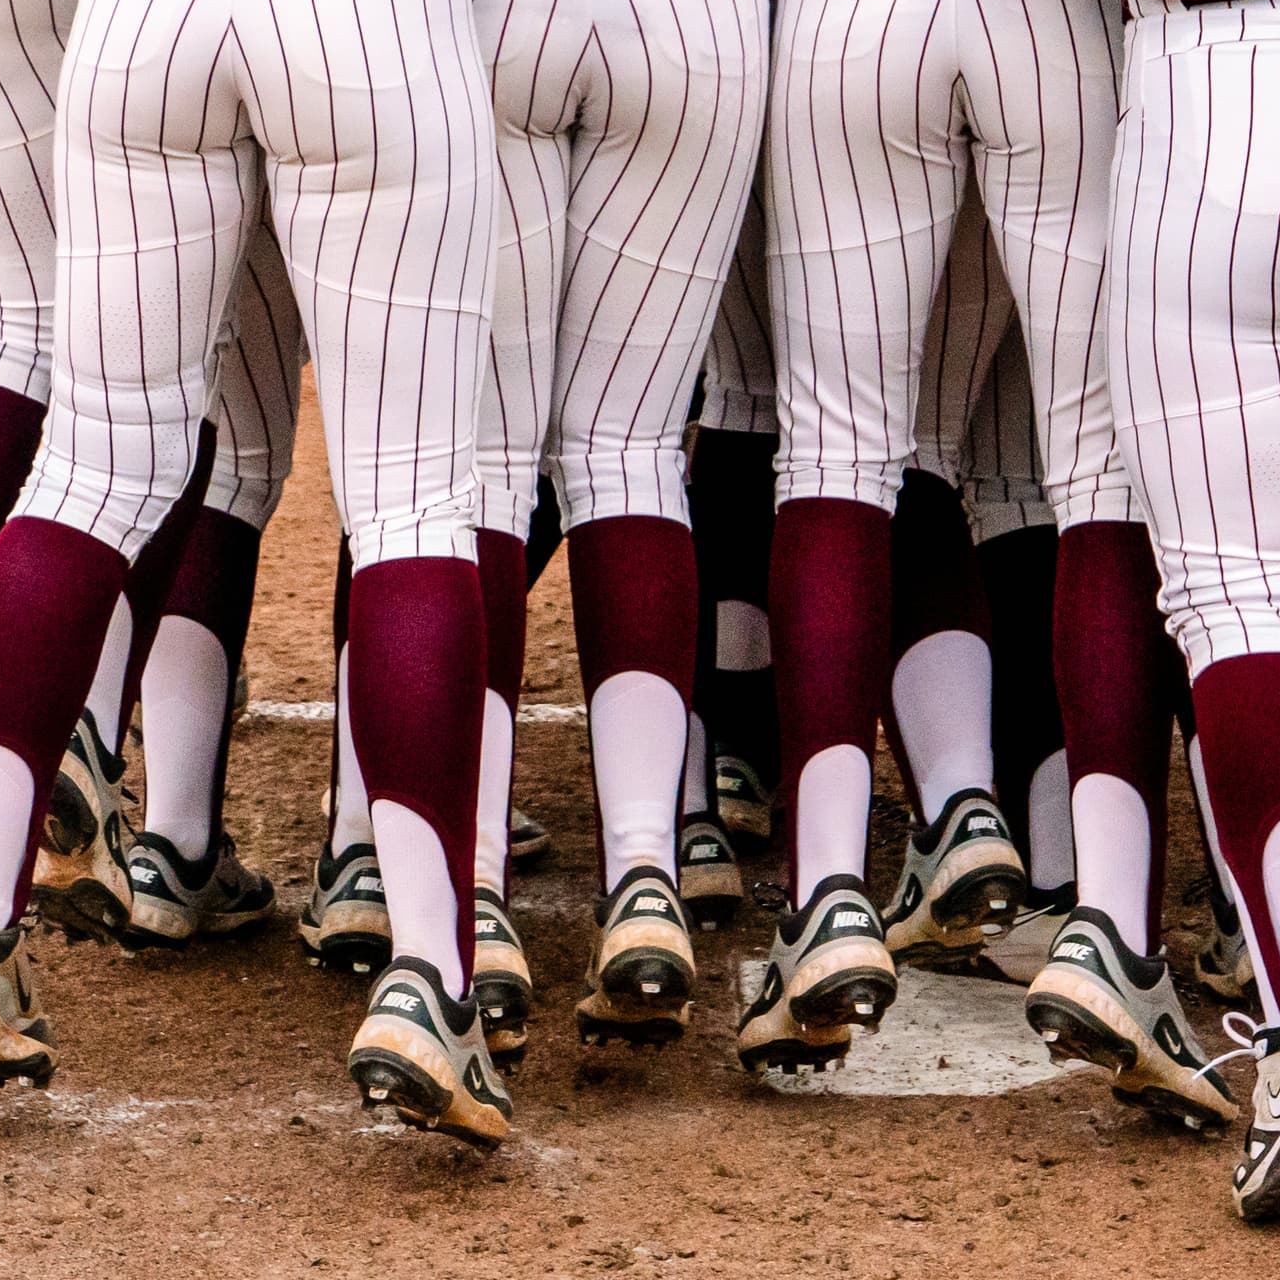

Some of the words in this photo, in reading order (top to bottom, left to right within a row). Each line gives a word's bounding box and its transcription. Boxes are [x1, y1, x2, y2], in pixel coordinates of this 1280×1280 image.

[967, 816, 999, 832] NIKE
[632, 896, 670, 913] NIKE
[832, 911, 870, 929] NIKE
[1053, 942, 1095, 961] NIKE
[380, 991, 421, 1012] NIKE
